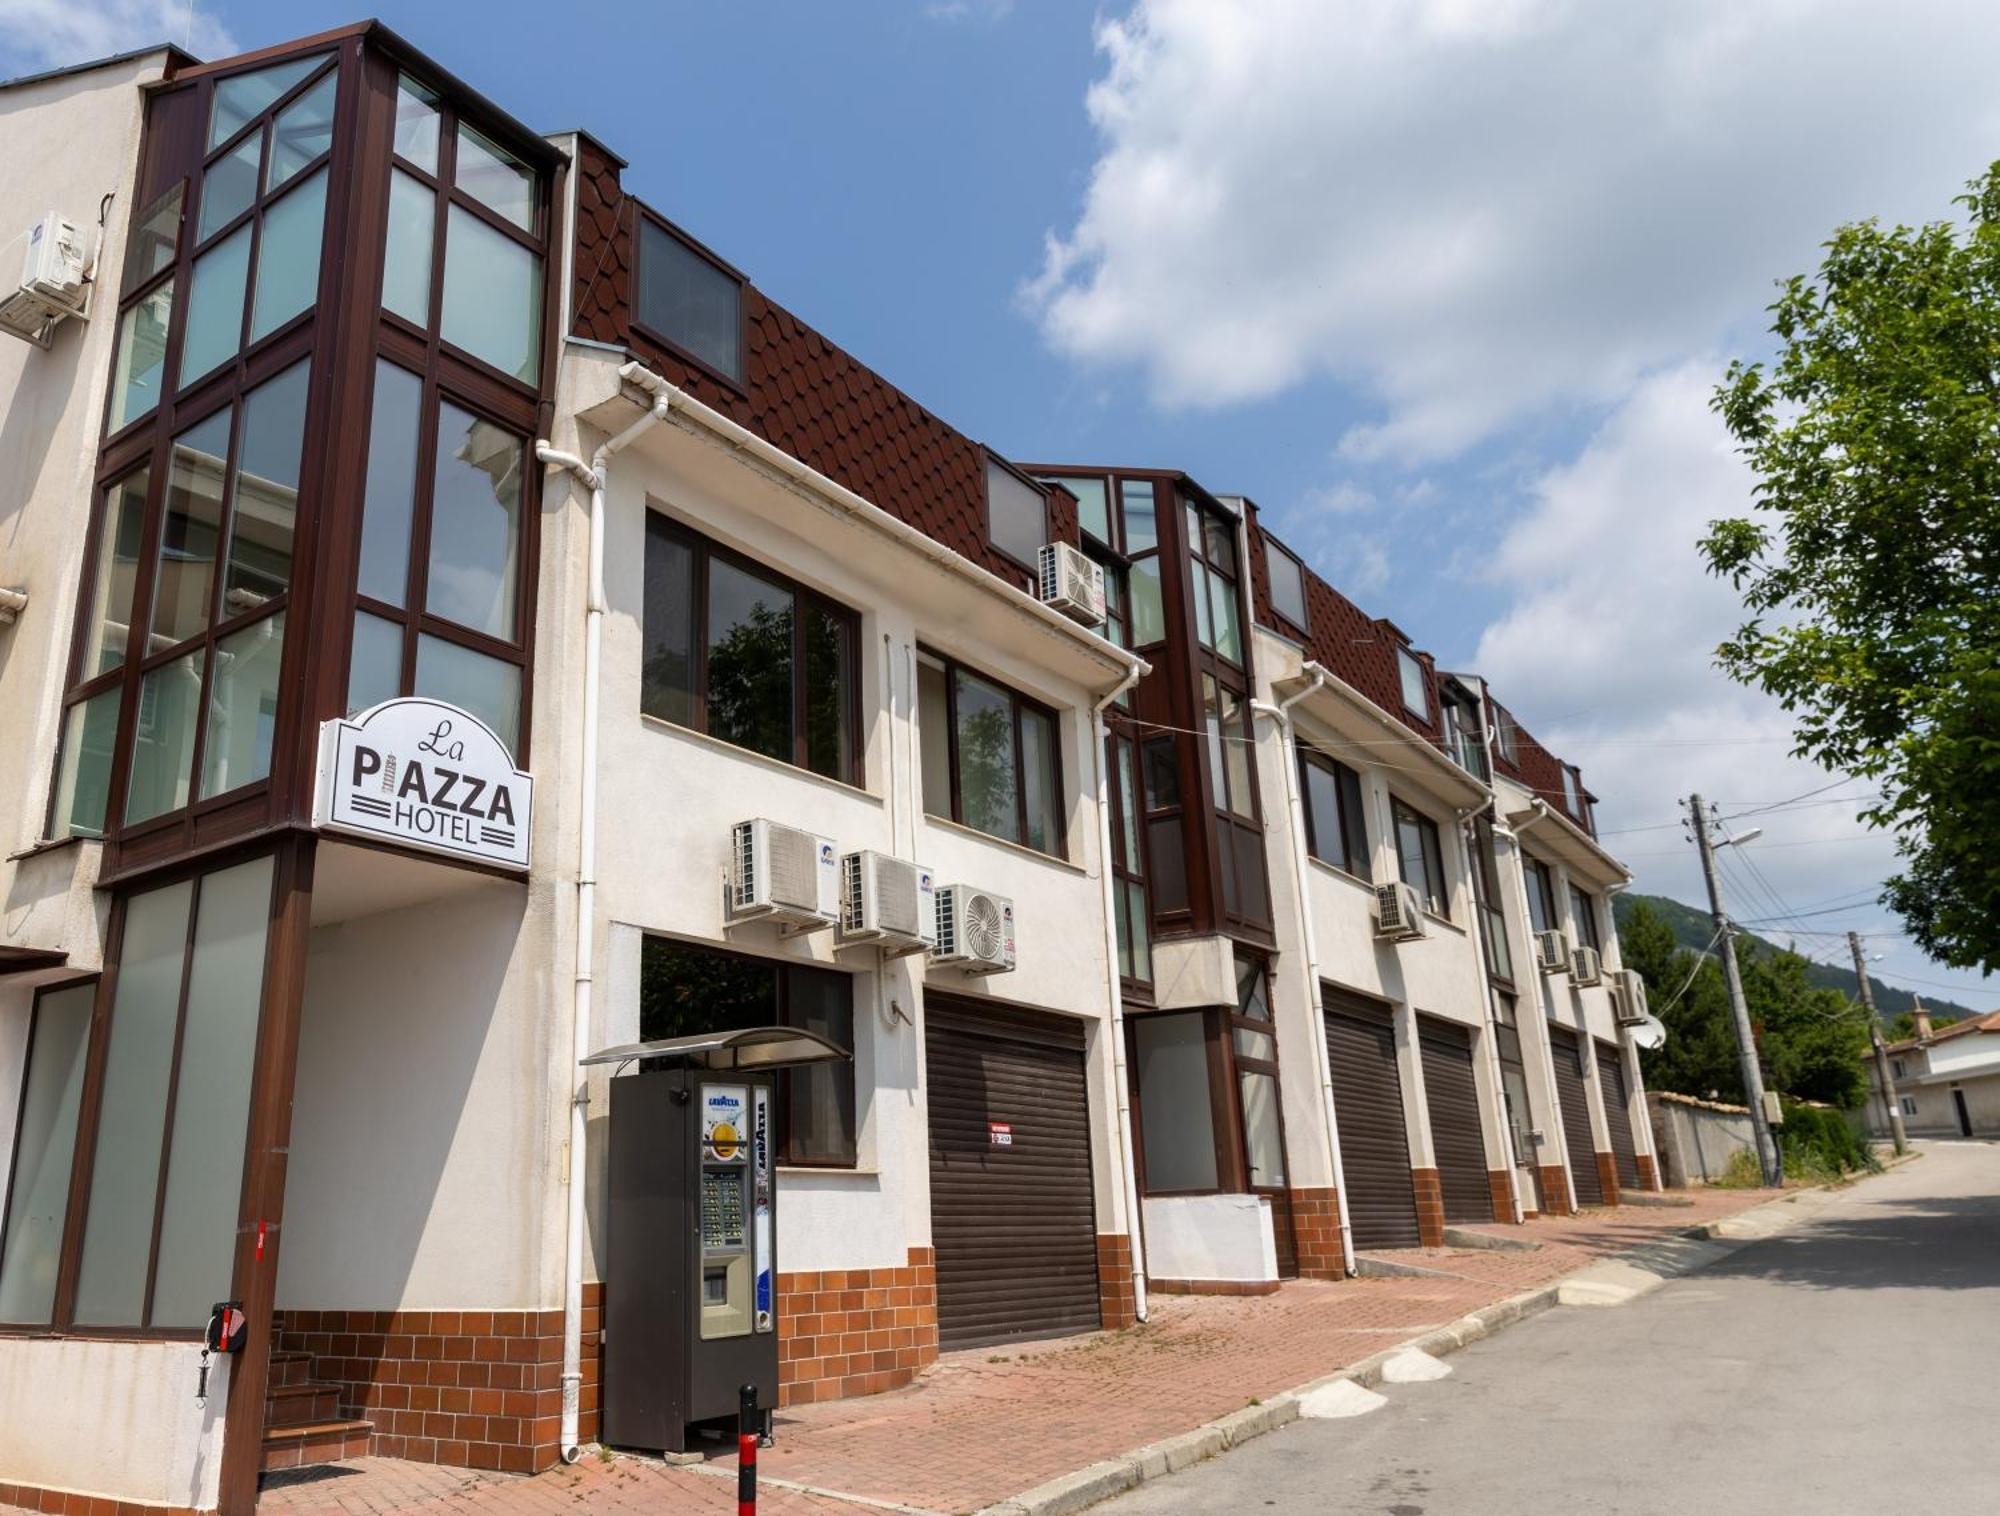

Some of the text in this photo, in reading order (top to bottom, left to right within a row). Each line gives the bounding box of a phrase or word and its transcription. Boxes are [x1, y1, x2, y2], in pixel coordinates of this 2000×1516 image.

[418, 720, 464, 762] La
[353, 745, 516, 826] PIAZZA
[395, 801, 477, 845] HOTEL
